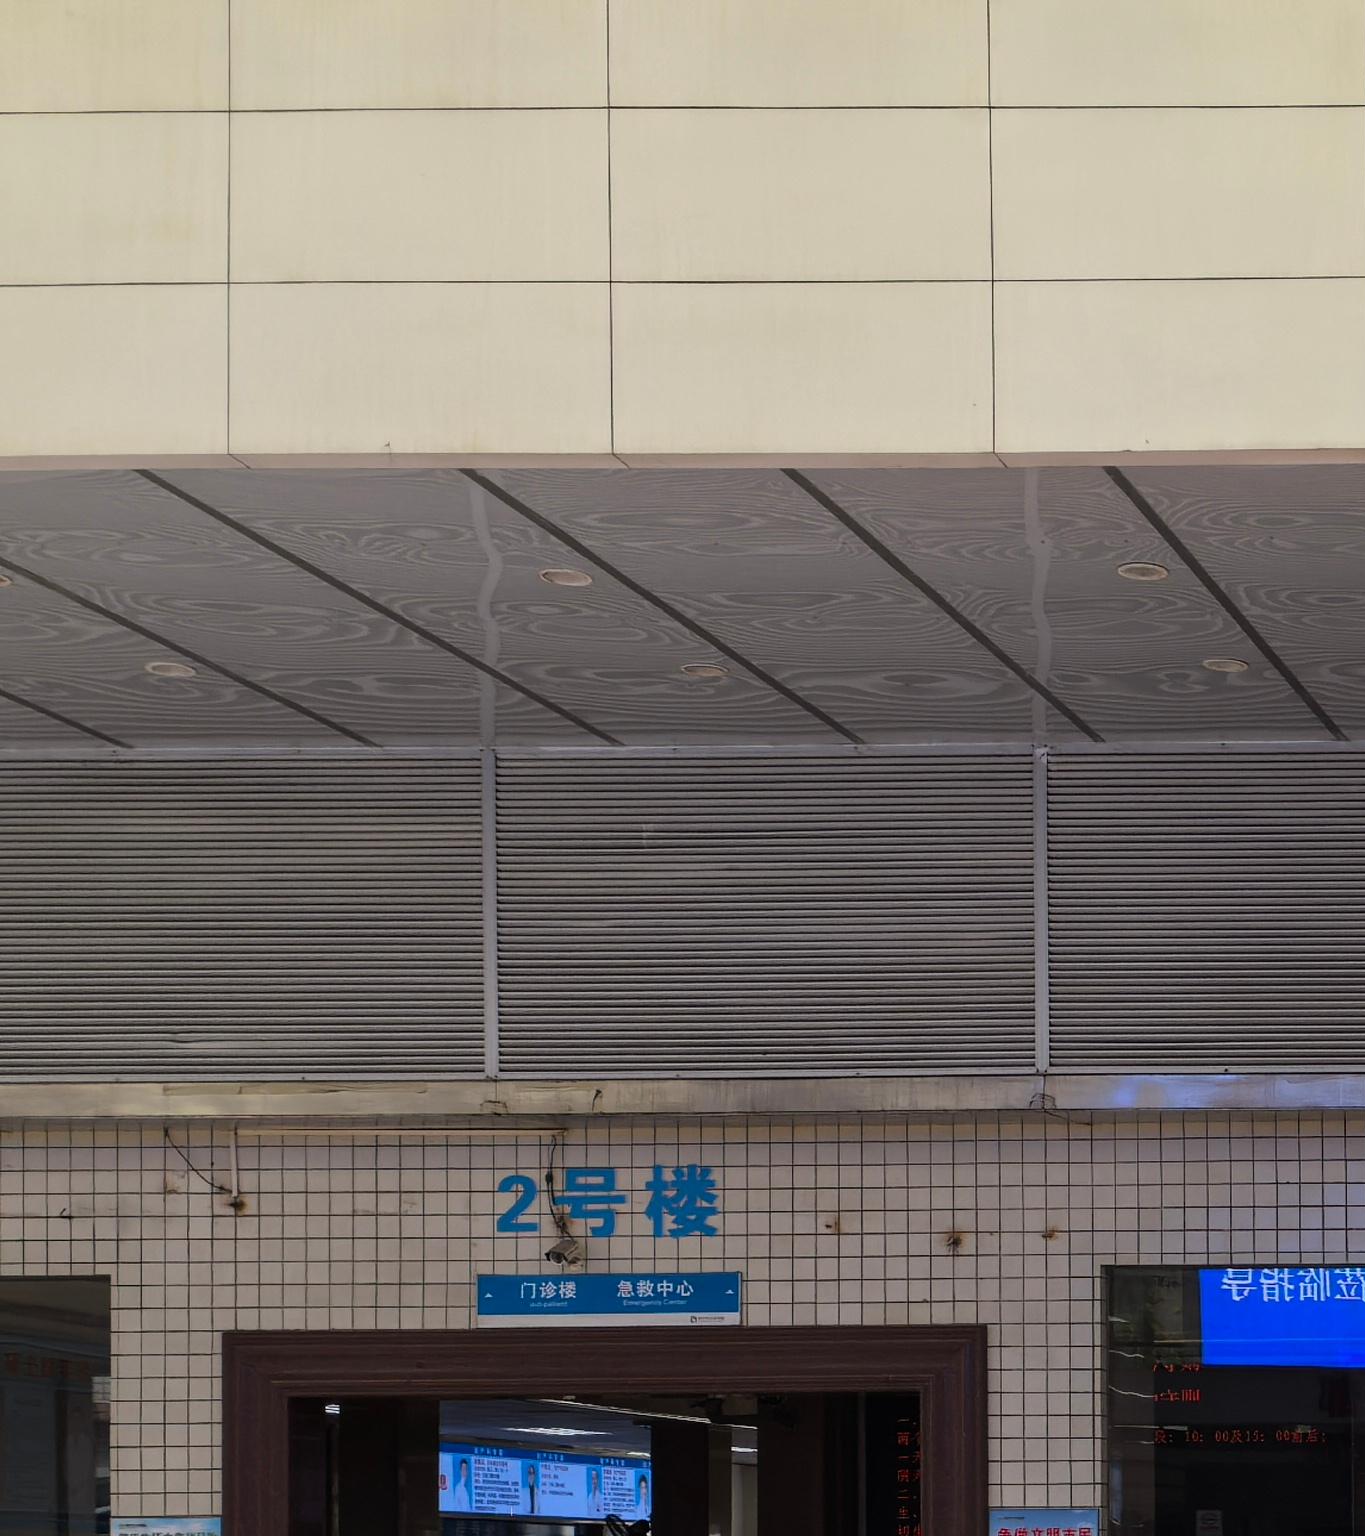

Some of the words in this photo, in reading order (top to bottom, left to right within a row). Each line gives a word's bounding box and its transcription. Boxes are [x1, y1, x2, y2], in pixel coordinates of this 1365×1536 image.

[496, 1164, 719, 1238] 2号楼
[520, 1281, 577, 1299] 门诊楼
[616, 1279, 695, 1298] 急救中心
